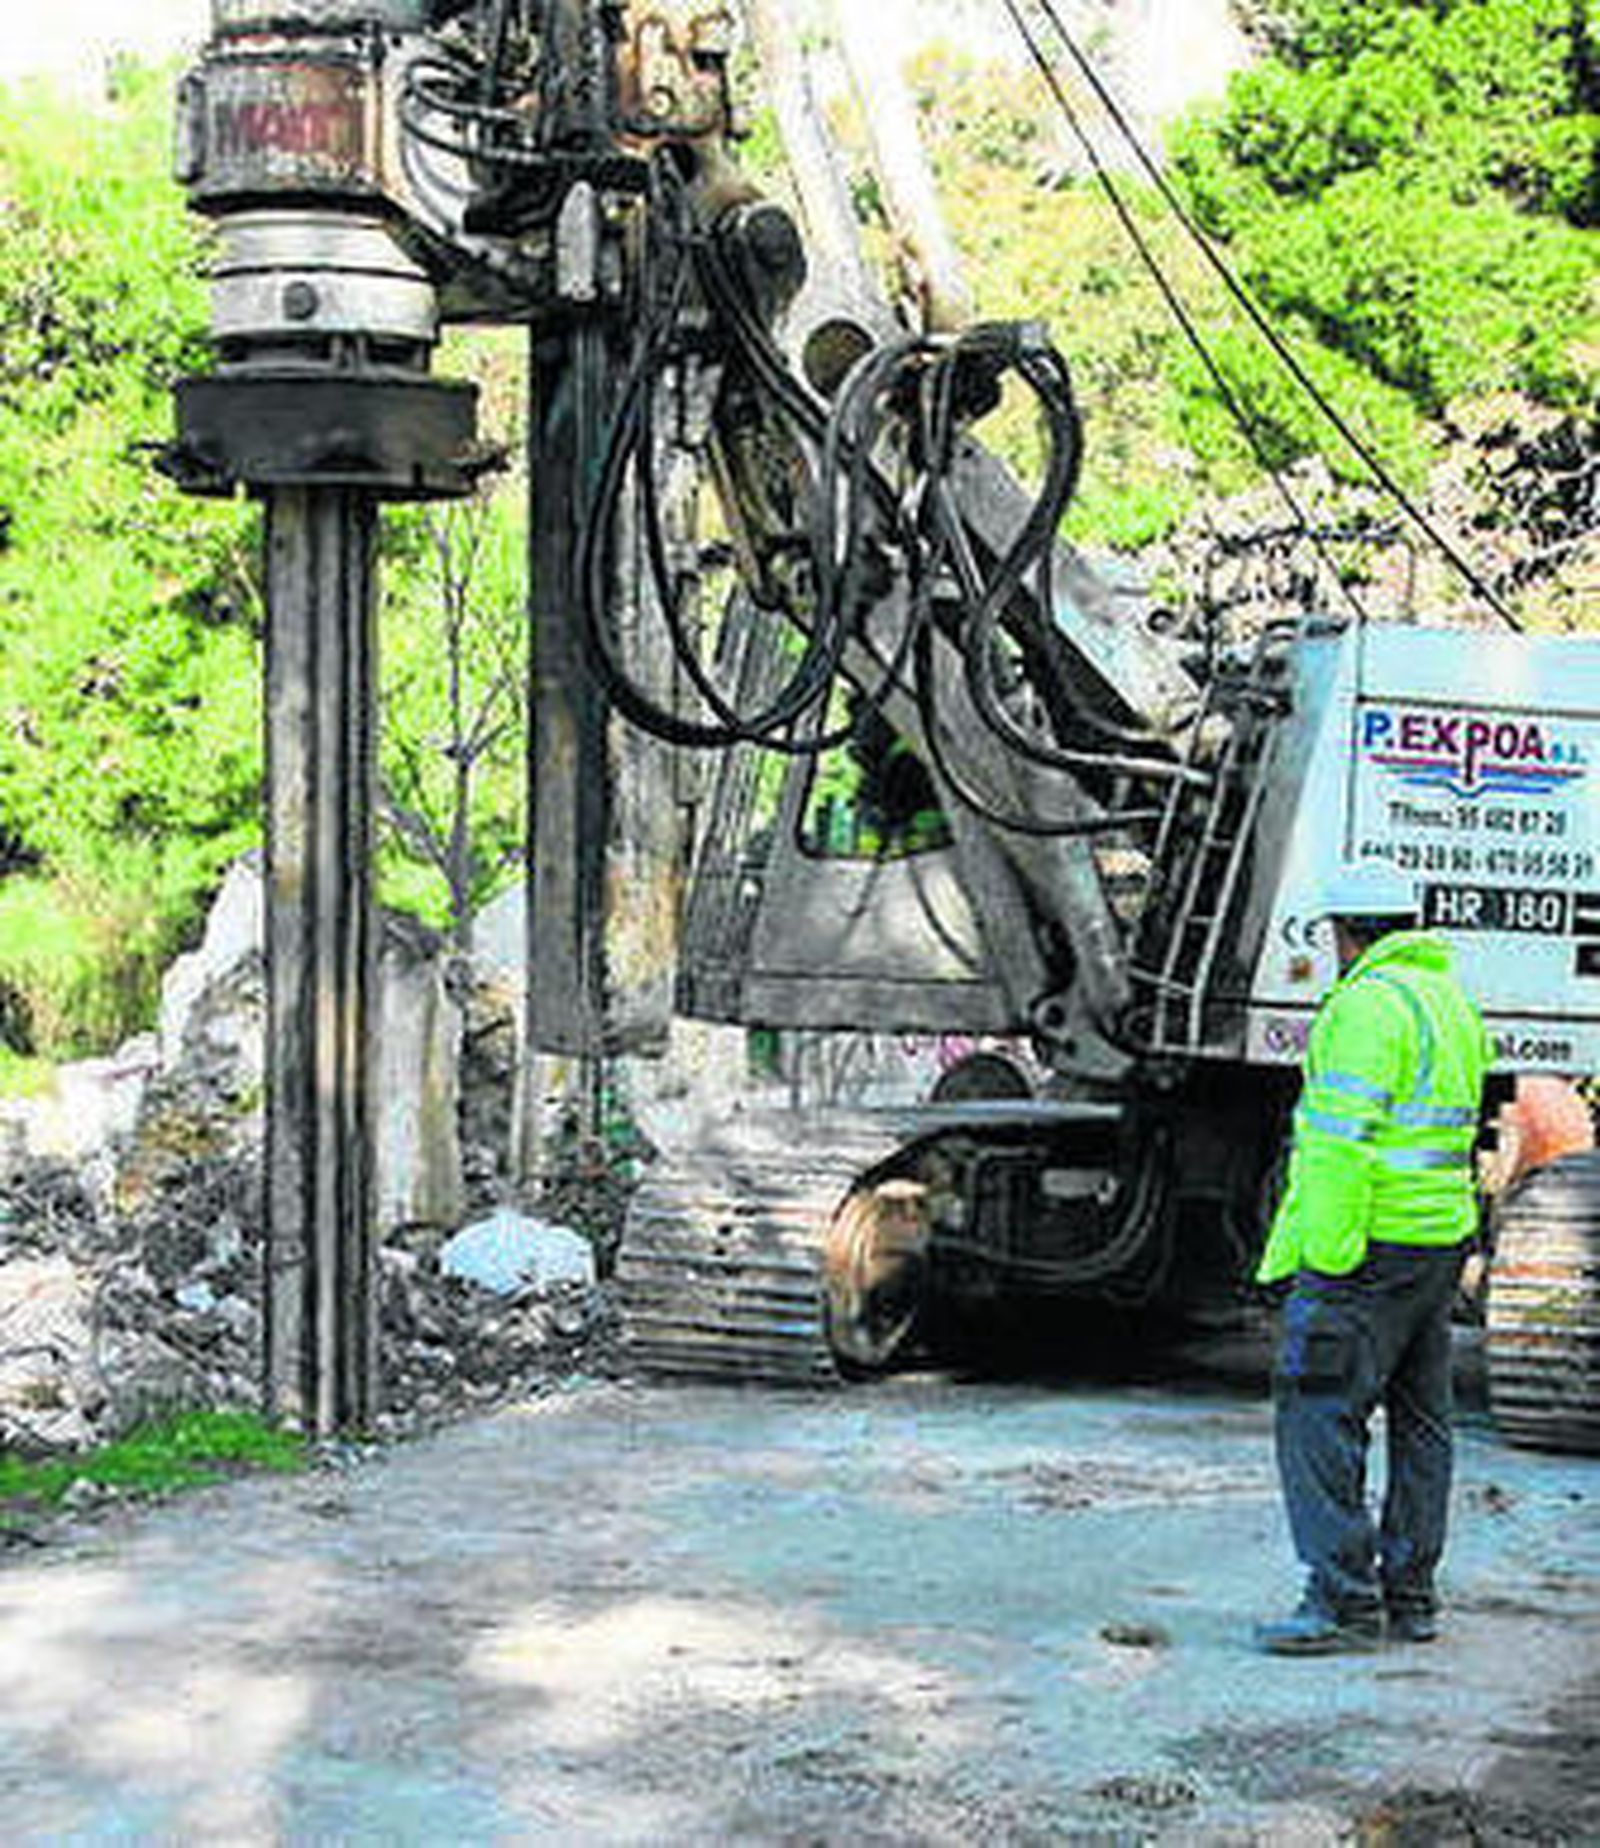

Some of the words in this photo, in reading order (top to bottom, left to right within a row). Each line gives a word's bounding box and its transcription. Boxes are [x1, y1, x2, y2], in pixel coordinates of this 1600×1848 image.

[1364, 712, 1546, 785] P.EXPOA
[1435, 889, 1483, 931] HR
[1503, 892, 1562, 930] 180
